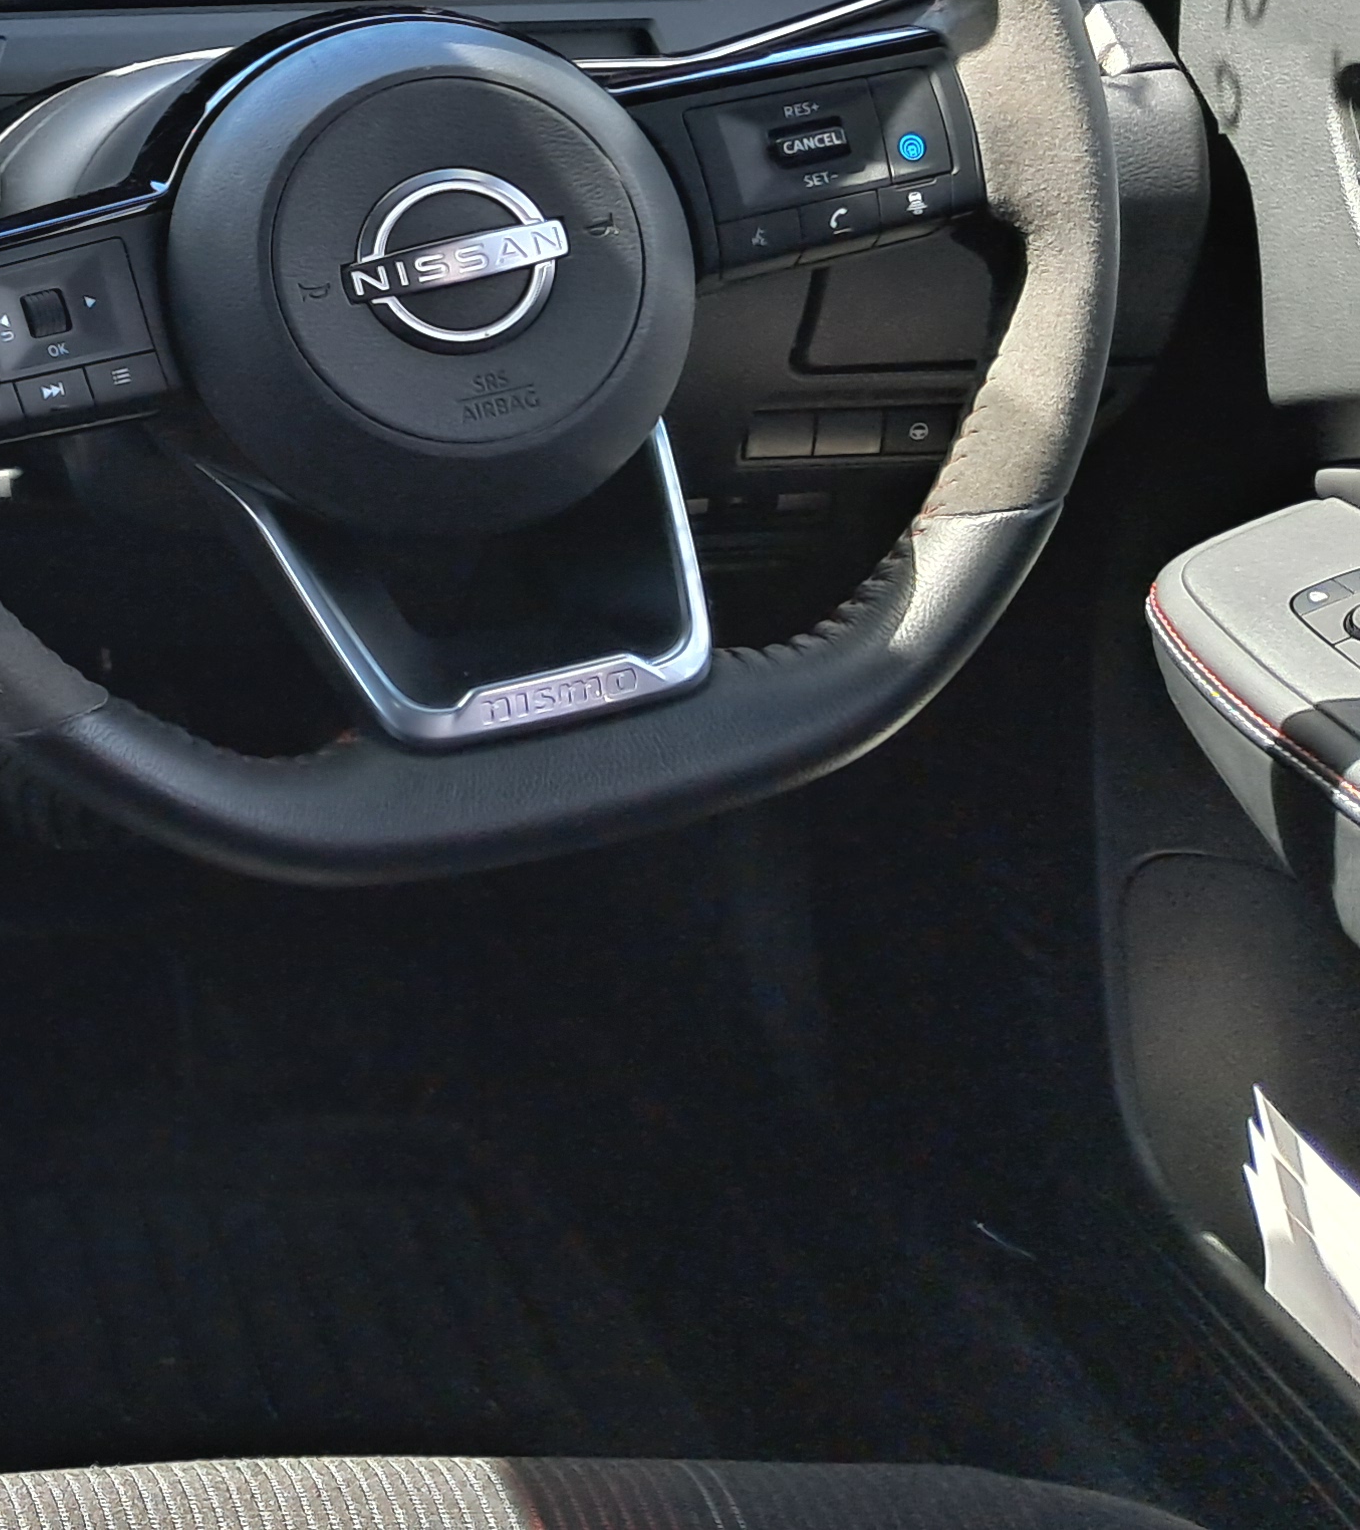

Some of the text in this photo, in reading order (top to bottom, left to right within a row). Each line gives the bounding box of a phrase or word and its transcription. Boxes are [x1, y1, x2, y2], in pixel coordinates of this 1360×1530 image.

[783, 132, 842, 154] CANCEL
[350, 226, 564, 297] NISSAN
[47, 342, 69, 358] OK
[471, 372, 510, 392] SRS
[462, 391, 540, 423] AIRBAG
